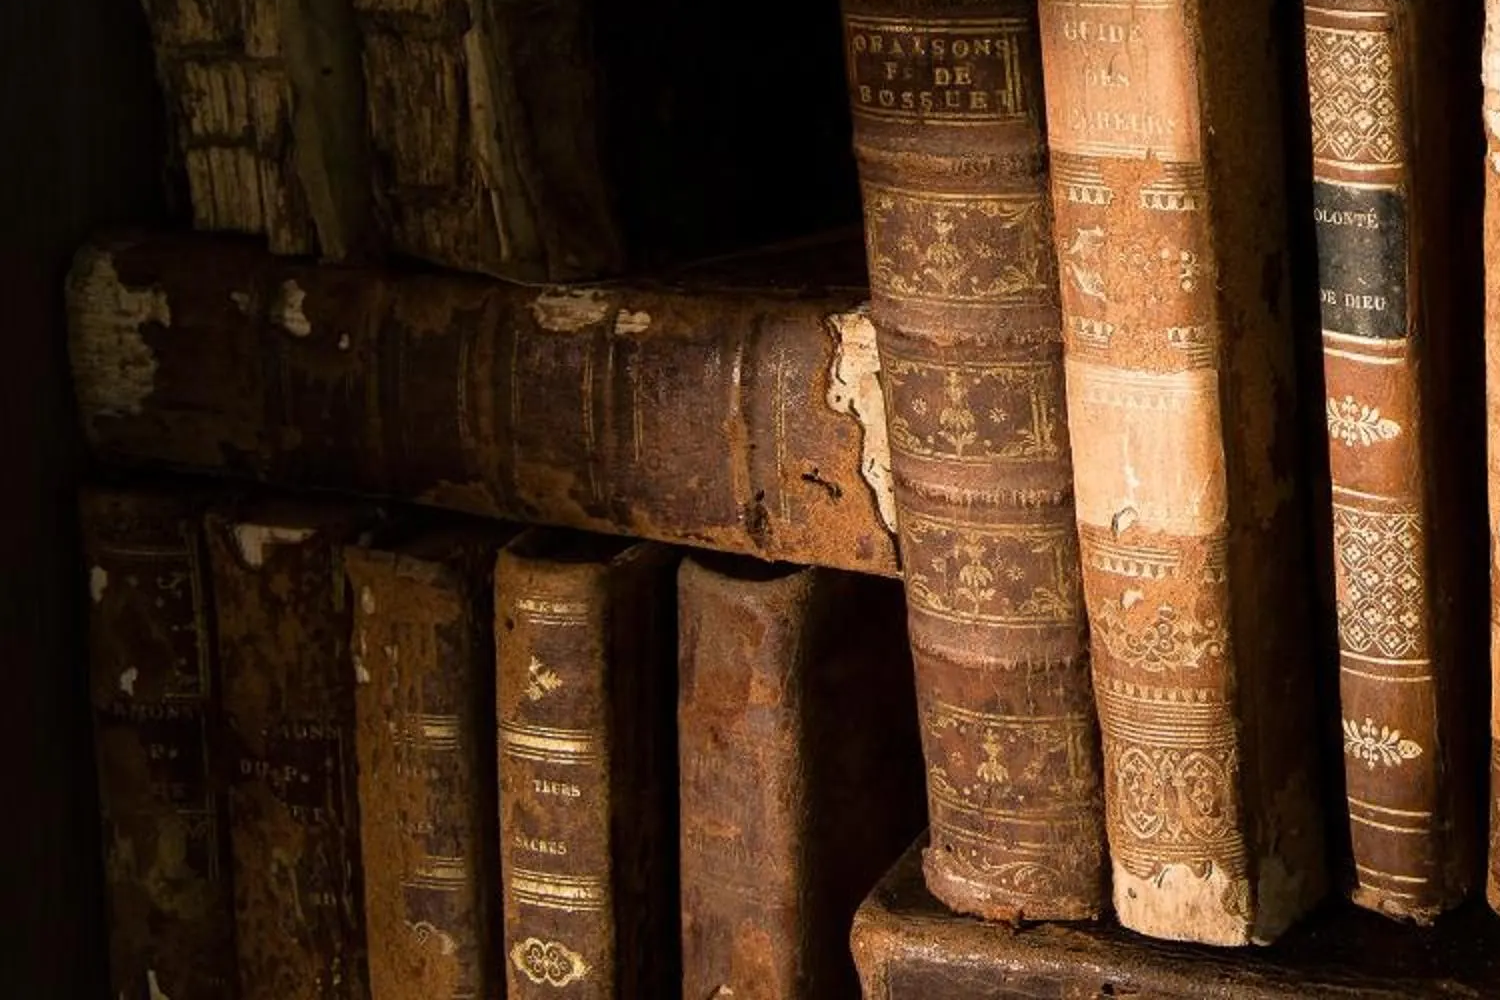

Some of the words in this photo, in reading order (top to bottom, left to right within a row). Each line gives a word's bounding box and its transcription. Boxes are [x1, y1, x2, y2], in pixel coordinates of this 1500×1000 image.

[852, 34, 1010, 57] ORAISONS
[934, 66, 973, 86] DE
[858, 84, 1009, 110] BOSSUET
[1313, 207, 1380, 230] OLONTÉ
[1344, 292, 1388, 312] DIEU
